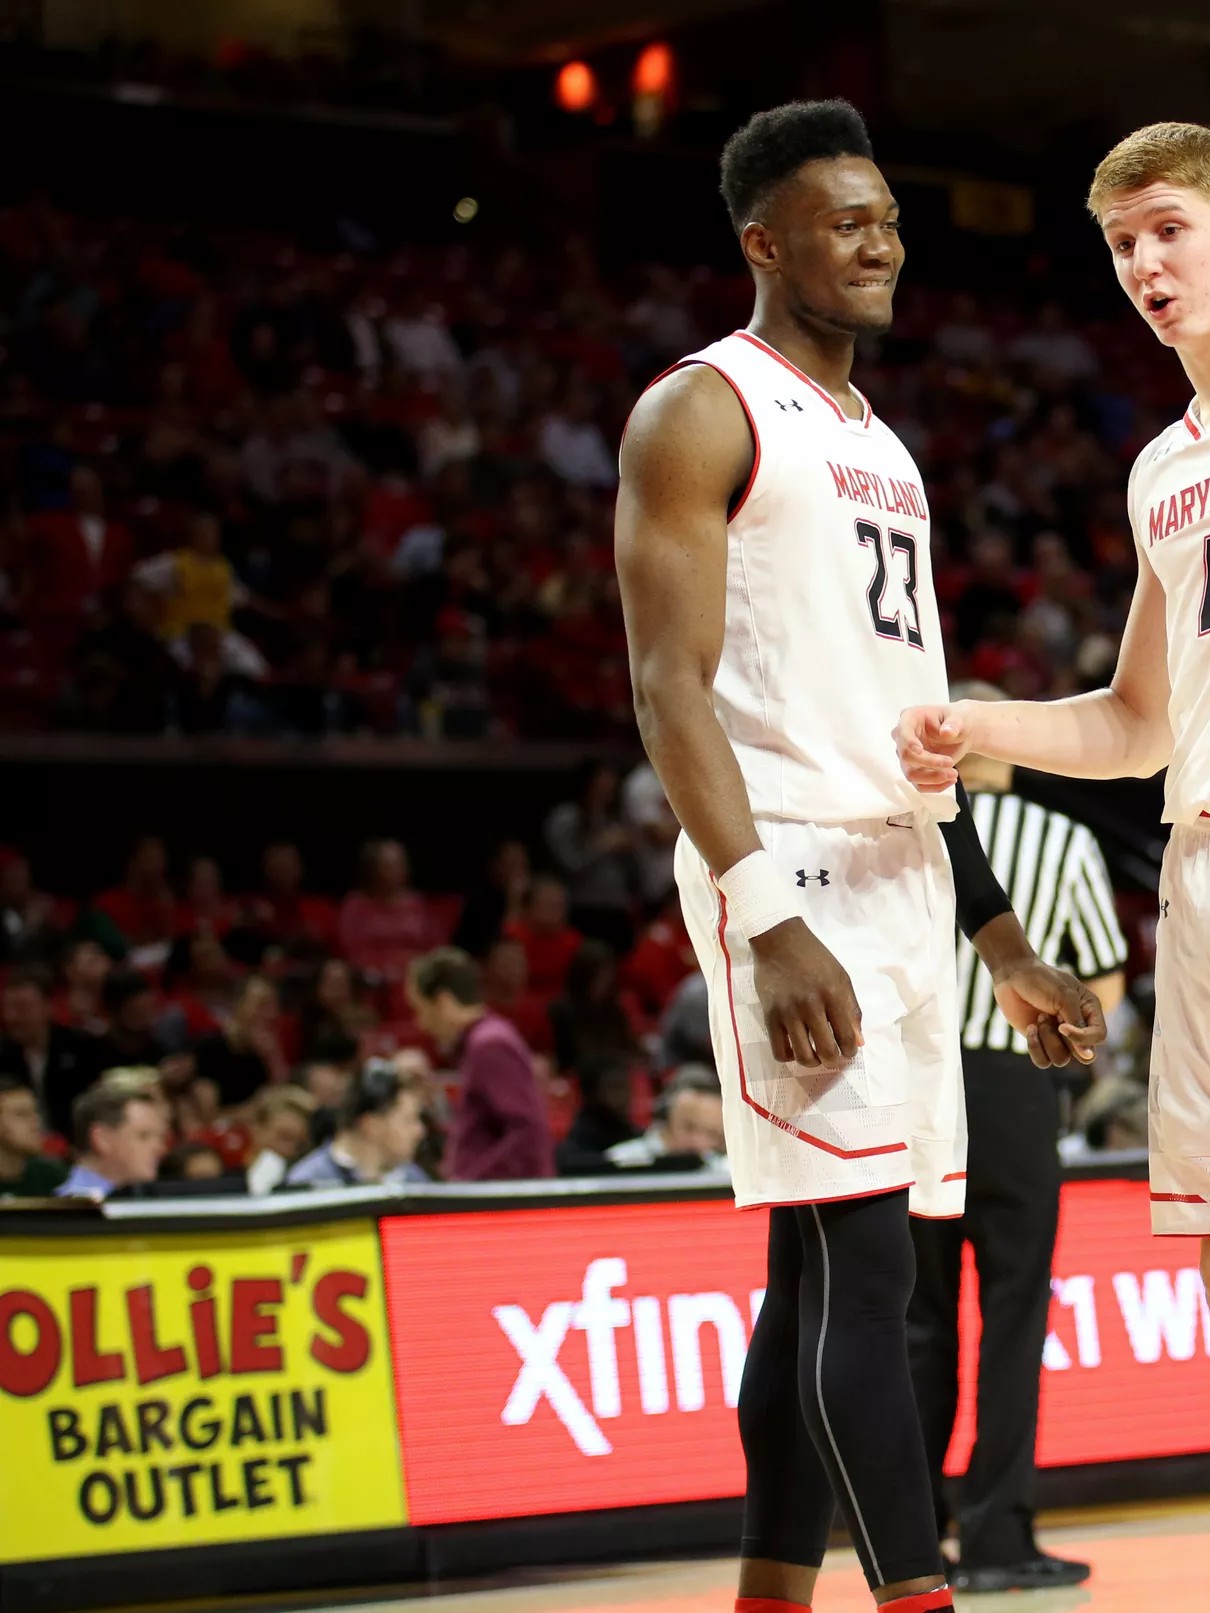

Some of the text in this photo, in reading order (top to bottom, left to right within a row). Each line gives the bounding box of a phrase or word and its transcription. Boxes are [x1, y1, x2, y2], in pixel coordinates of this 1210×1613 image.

[826, 461, 927, 521] MARYLAND
[854, 517, 926, 653] 23
[47, 1387, 328, 1463] BARGAIN
[78, 1454, 311, 1526] OUTLET
